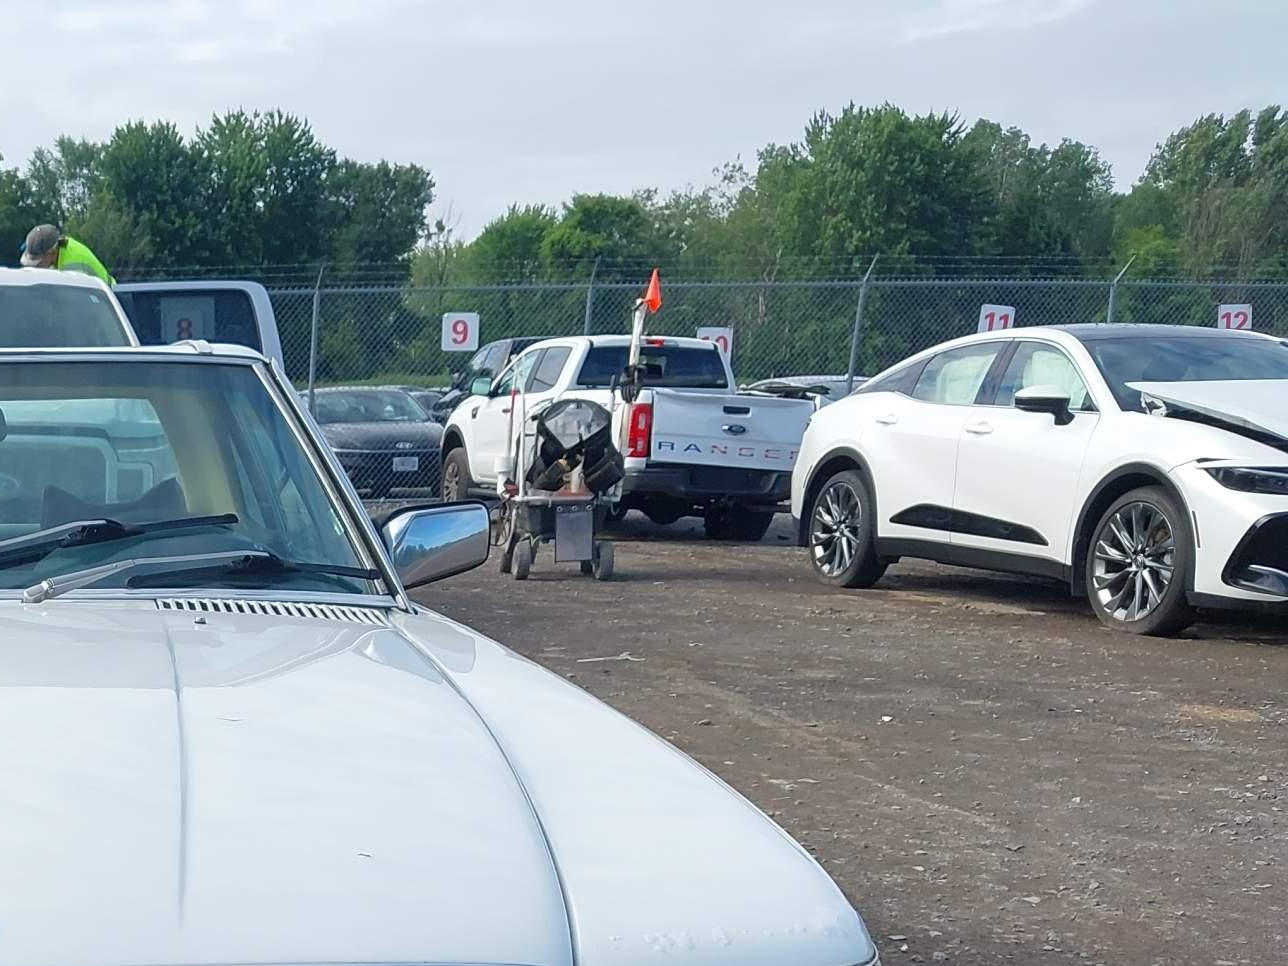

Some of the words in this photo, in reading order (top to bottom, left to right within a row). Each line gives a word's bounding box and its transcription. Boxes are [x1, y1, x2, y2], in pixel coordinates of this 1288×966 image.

[176, 318, 193, 341] 8
[452, 319, 468, 345] 9
[984, 311, 1010, 332] 11
[1221, 311, 1249, 331] 12
